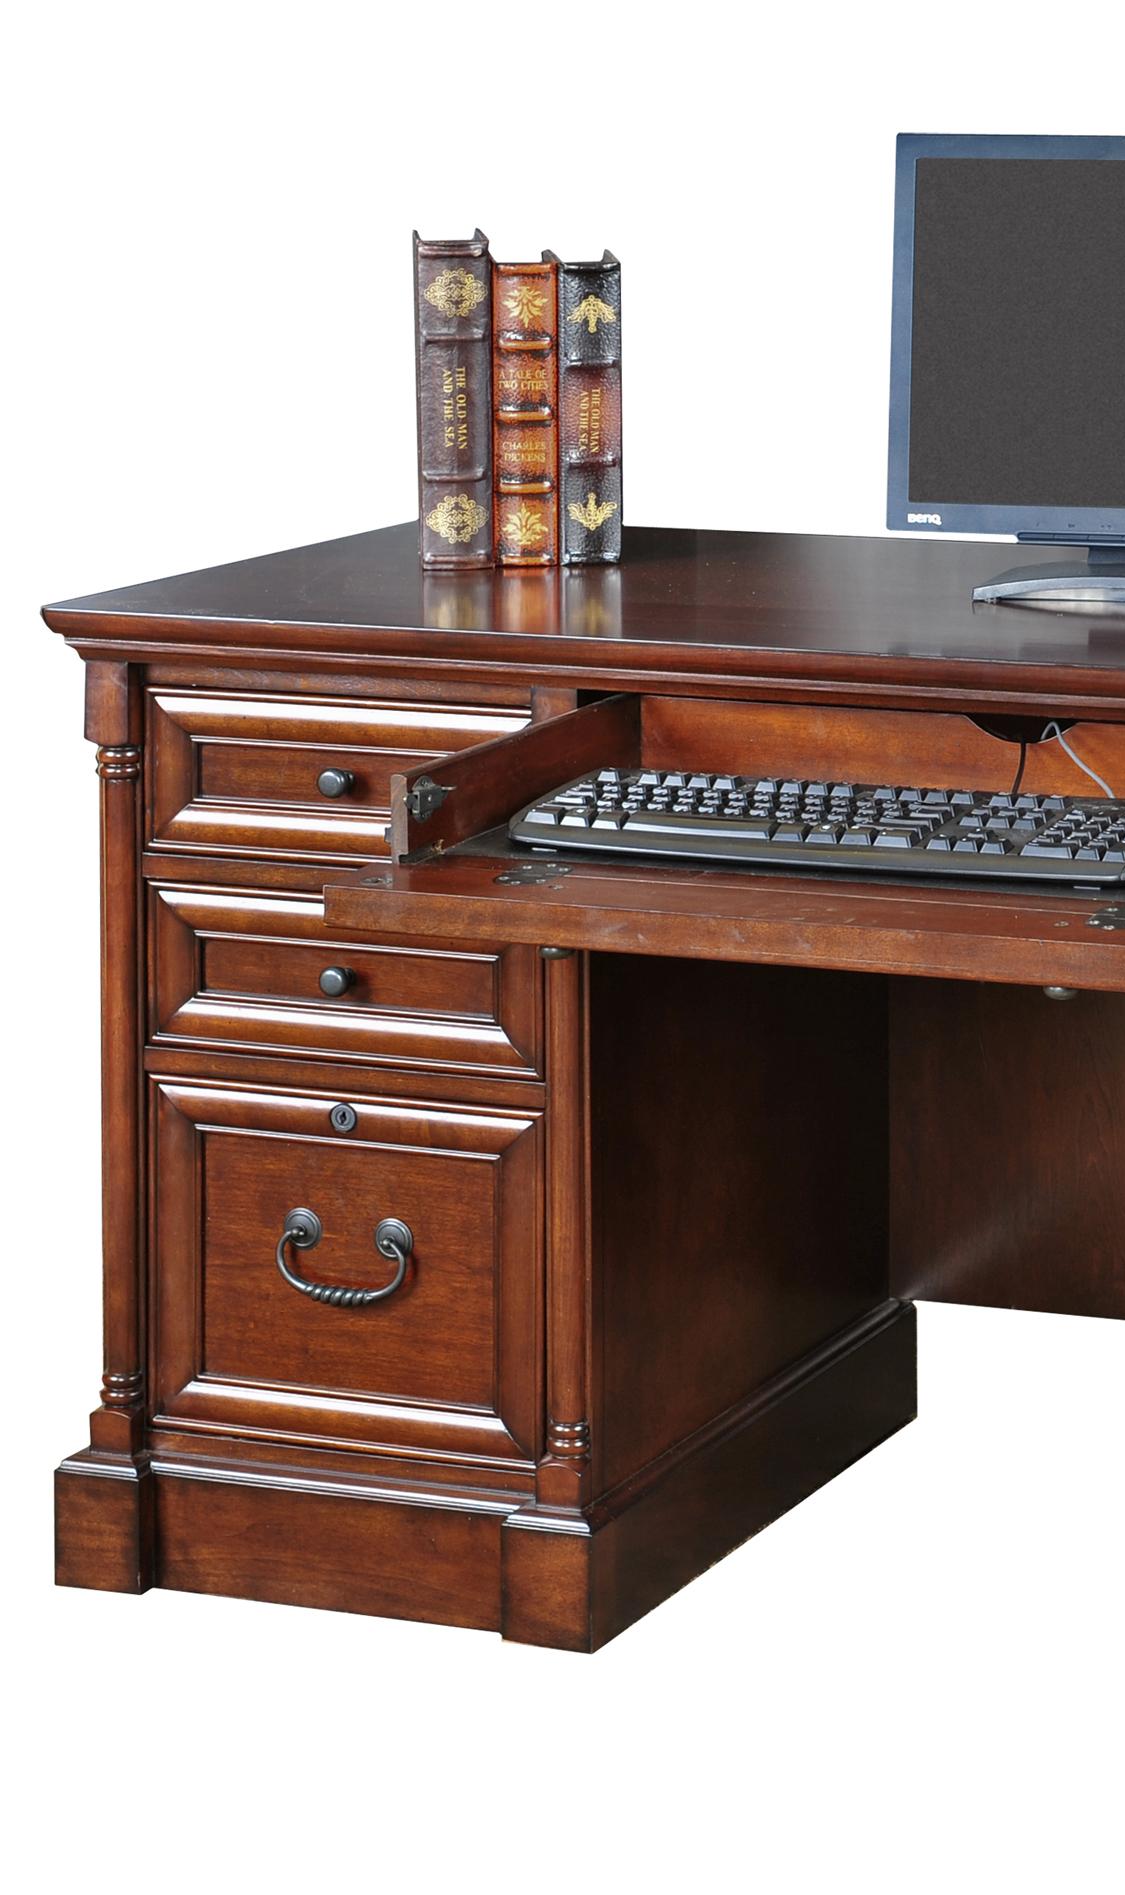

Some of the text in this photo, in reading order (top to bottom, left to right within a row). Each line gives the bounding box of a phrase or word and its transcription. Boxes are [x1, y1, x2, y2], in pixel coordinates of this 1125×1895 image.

[499, 369, 547, 379] A TALE OF
[498, 380, 549, 390] TWO CITIES
[442, 367, 455, 448] AND THE SEA
[456, 367, 468, 449] THE OLD MAN
[578, 390, 589, 451] AND THE SEA
[590, 388, 601, 453] THE OLD MAN
[502, 441, 546, 450] CHARLES
[504, 452, 546, 463] DICKENS
[907, 513, 942, 526] BenQ
